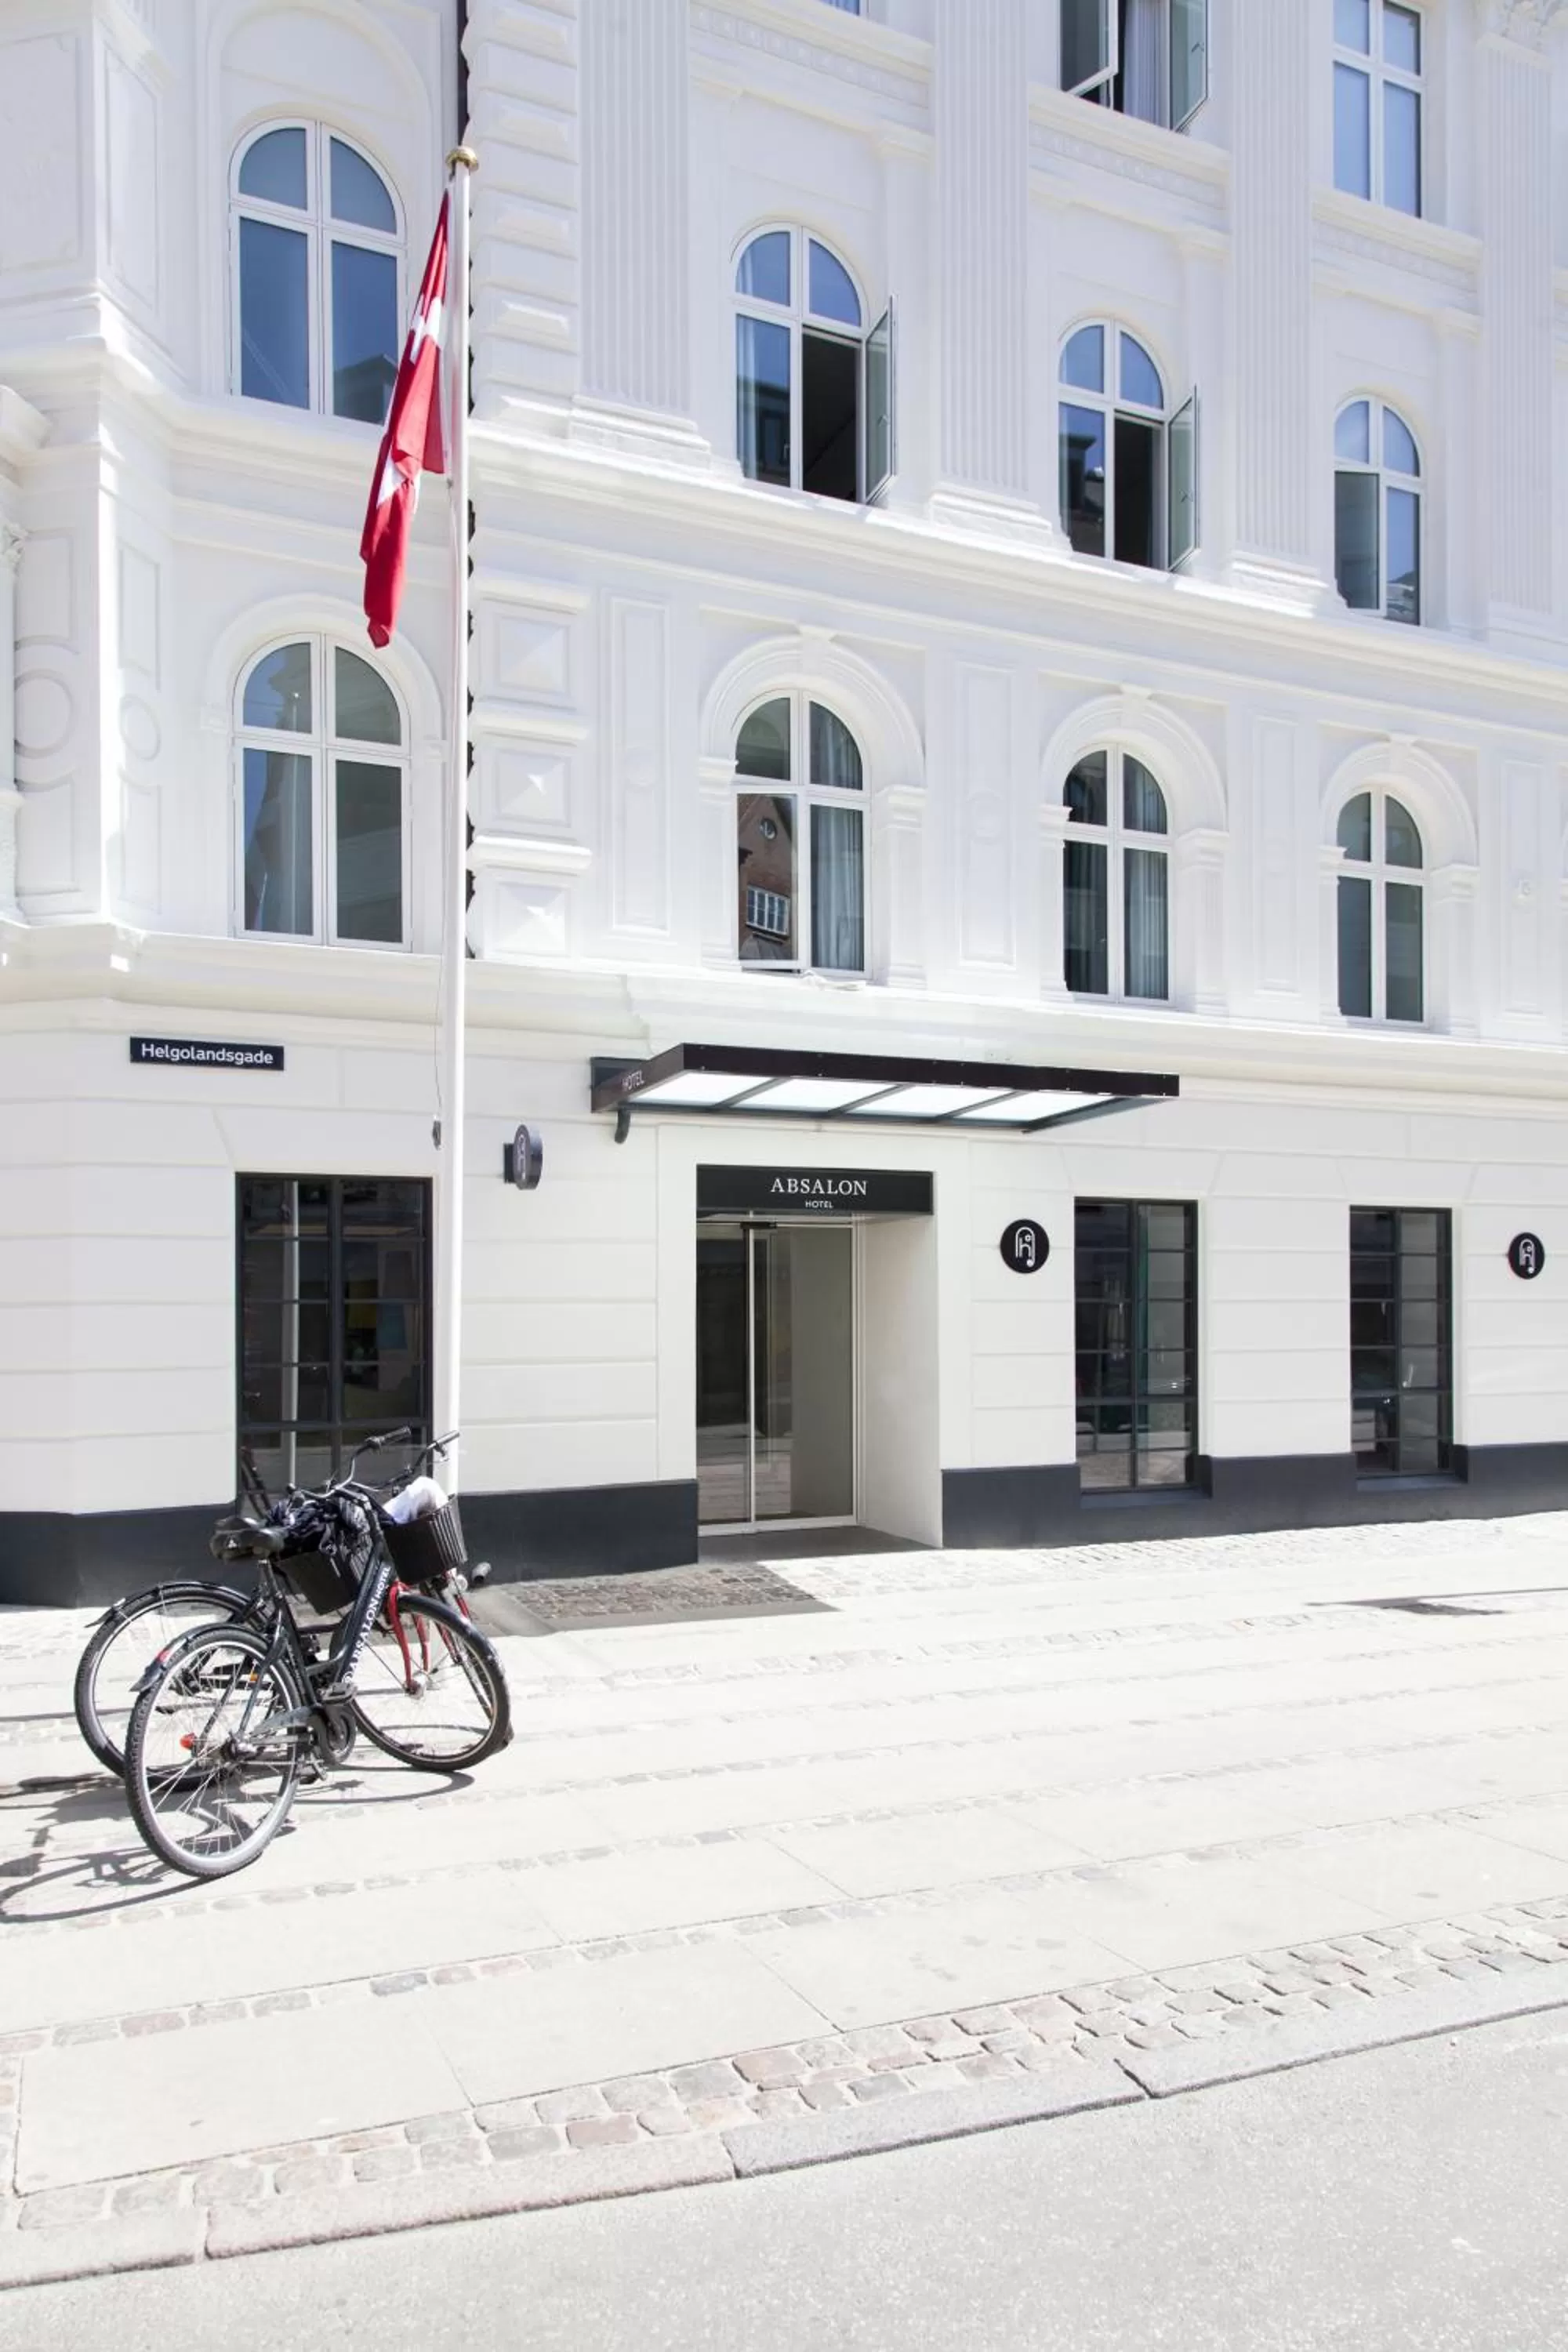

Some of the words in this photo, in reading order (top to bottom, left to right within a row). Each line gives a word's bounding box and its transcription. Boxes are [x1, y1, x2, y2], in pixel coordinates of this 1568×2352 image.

[141, 1043, 274, 1065] Helgolandsgade
[622, 1069, 644, 1091] HOTEL
[770, 1178, 867, 1196] ABSALON
[350, 1598, 379, 1671] ABSALON
[376, 1566, 391, 1599] HOTEL
